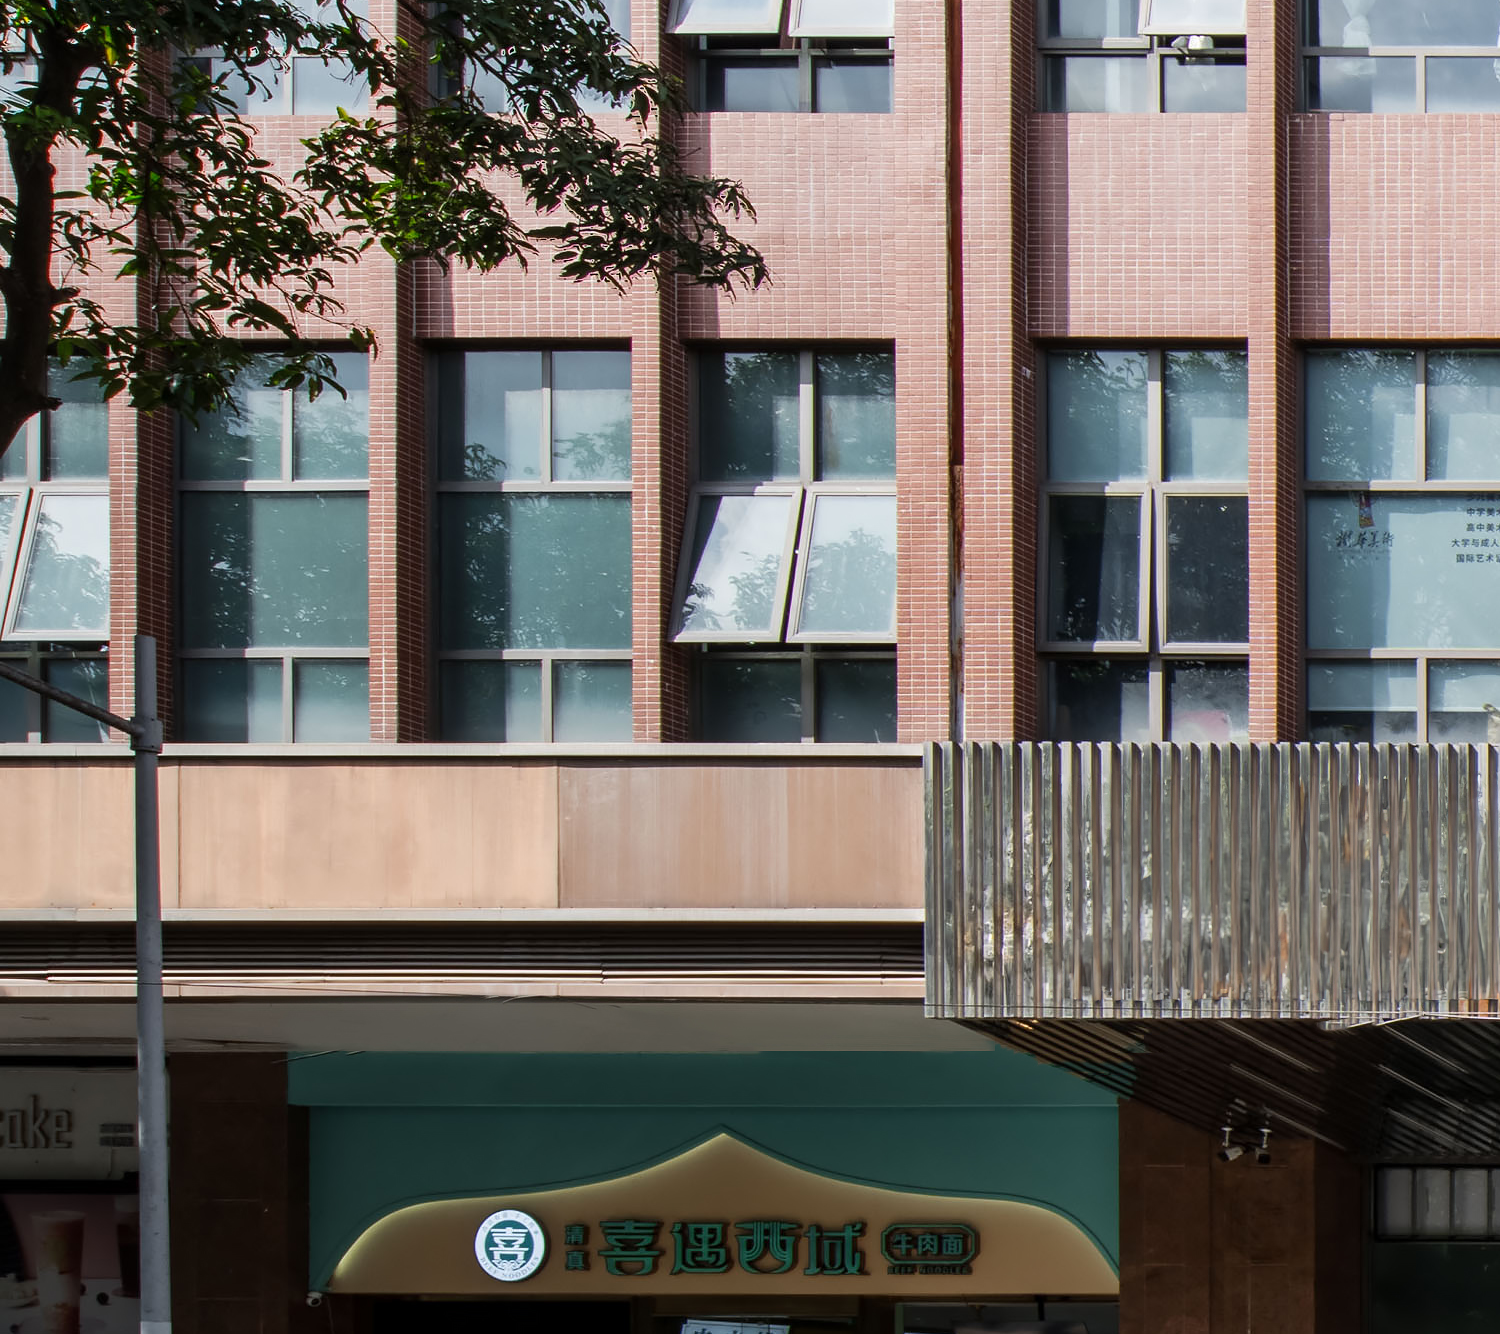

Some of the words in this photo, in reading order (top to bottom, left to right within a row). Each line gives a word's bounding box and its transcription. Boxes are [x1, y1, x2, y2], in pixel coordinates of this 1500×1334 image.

[0, 1094, 73, 1149] ake
[598, 1219, 863, 1276] 喜遇西域
[892, 1232, 964, 1256] 牛肉面
